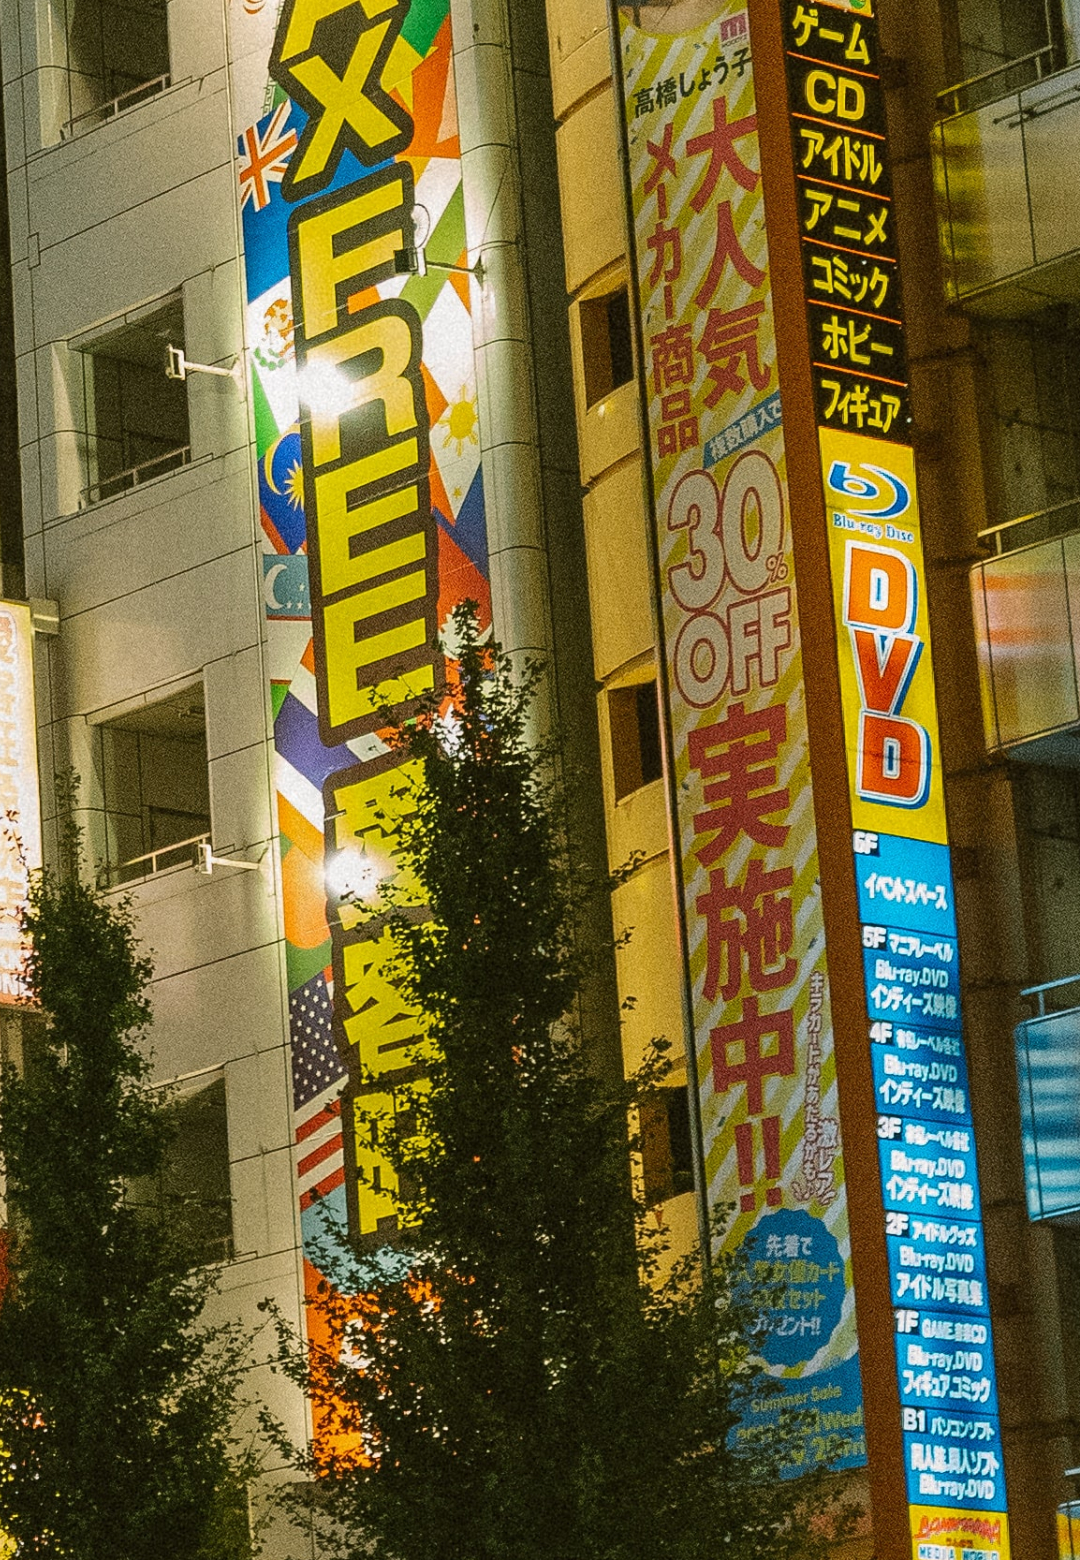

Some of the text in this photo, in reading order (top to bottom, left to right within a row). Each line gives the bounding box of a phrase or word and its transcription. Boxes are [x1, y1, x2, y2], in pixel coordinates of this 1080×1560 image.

[792, 3, 872, 66] ゲーム
[632, 46, 753, 119] 高橋しょう子
[804, 70, 866, 121] CD
[800, 127, 883, 186] アイドル
[804, 188, 889, 244] アニメ
[684, 95, 769, 409] 大人気
[643, 122, 700, 458] メーカー商品
[813, 255, 890, 308] コミック
[821, 316, 894, 368] ホビー
[821, 380, 901, 433] フィギュア
[292, 168, 438, 734] FREE
[885, 524, 915, 543] Disc
[673, 586, 792, 711] OFF
[843, 536, 930, 810] DVD
[852, 830, 879, 855] 6F
[687, 700, 797, 1213] 実施中!!
[862, 925, 887, 950] 5F
[868, 1021, 893, 1045] 4F
[876, 1115, 902, 1140] 3F
[885, 1211, 910, 1236] 2F
[895, 1272, 984, 1307] アイドル写真集
[895, 1309, 920, 1334] 1F
[902, 1406, 927, 1433] B1
[919, 1544, 956, 1560] MEDIA
